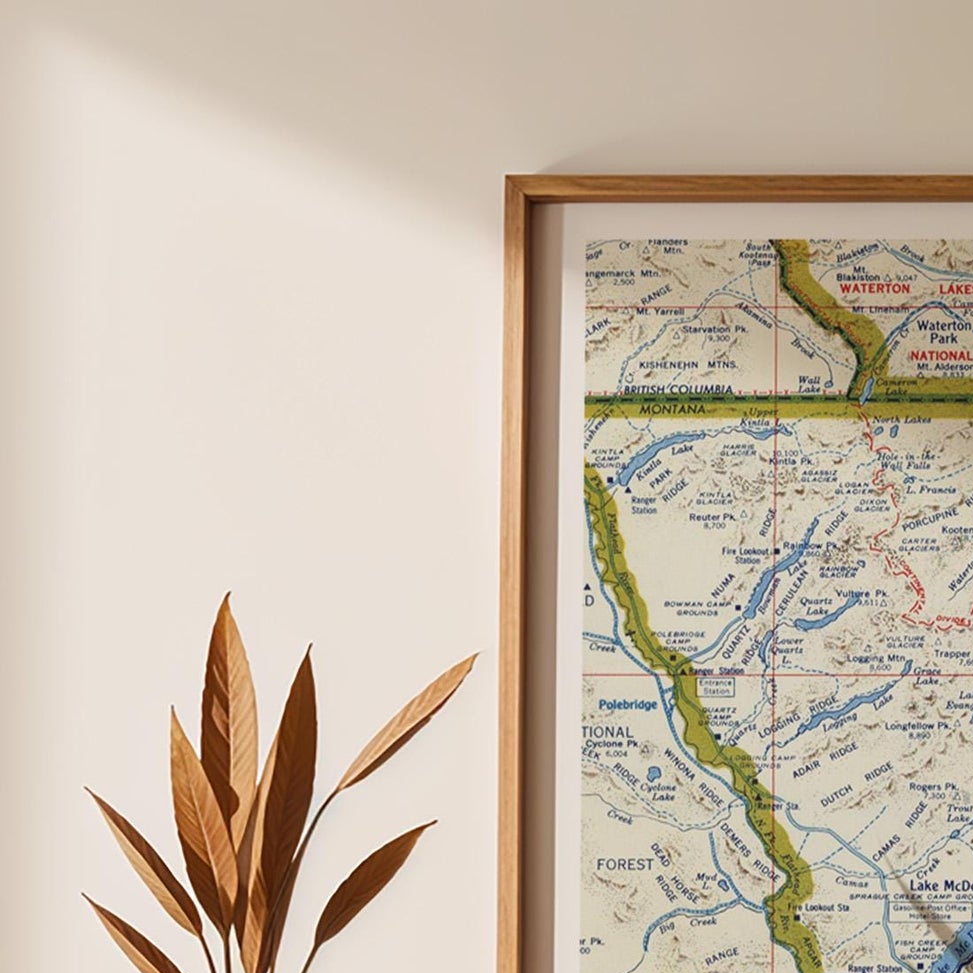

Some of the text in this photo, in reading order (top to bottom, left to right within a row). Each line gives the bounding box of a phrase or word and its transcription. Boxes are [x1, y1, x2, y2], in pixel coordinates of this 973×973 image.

[840, 284, 910, 293] WATERTON
[641, 284, 672, 305] RANGE
[917, 321, 972, 331] Waterton
[931, 333, 957, 343] Park
[911, 351, 973, 360] NATIONAL
[640, 361, 698, 369] KISHENEHN
[624, 385, 732, 394] BRITISH COLUMBIA
[640, 405, 705, 414] MONTANA
[650, 469, 672, 488] PARK
[662, 479, 689, 502] RIDGE
[919, 486, 956, 494] Francis
[632, 497, 656, 505] Ranger
[903, 508, 959, 532] PORCUPINE
[711, 573, 735, 599] NUMA
[722, 625, 751, 659] QUARTZ
[847, 655, 883, 663] Logging
[935, 650, 971, 658] Trapper
[600, 700, 657, 709] Polebridge
[886, 722, 934, 730] Longfellow
[586, 740, 623, 748] Cyclone
[664, 749, 695, 781] WINONA
[865, 762, 893, 782] RIDGE
[910, 783, 941, 791] Rogers
[872, 801, 928, 862] CAMAS RIDGE
[651, 843, 670, 867] DEAD
[720, 823, 781, 882] DEMERS RIDGE
[597, 859, 654, 870] FOREST
[910, 880, 938, 891] Lake
[705, 948, 739, 966] RANGE
